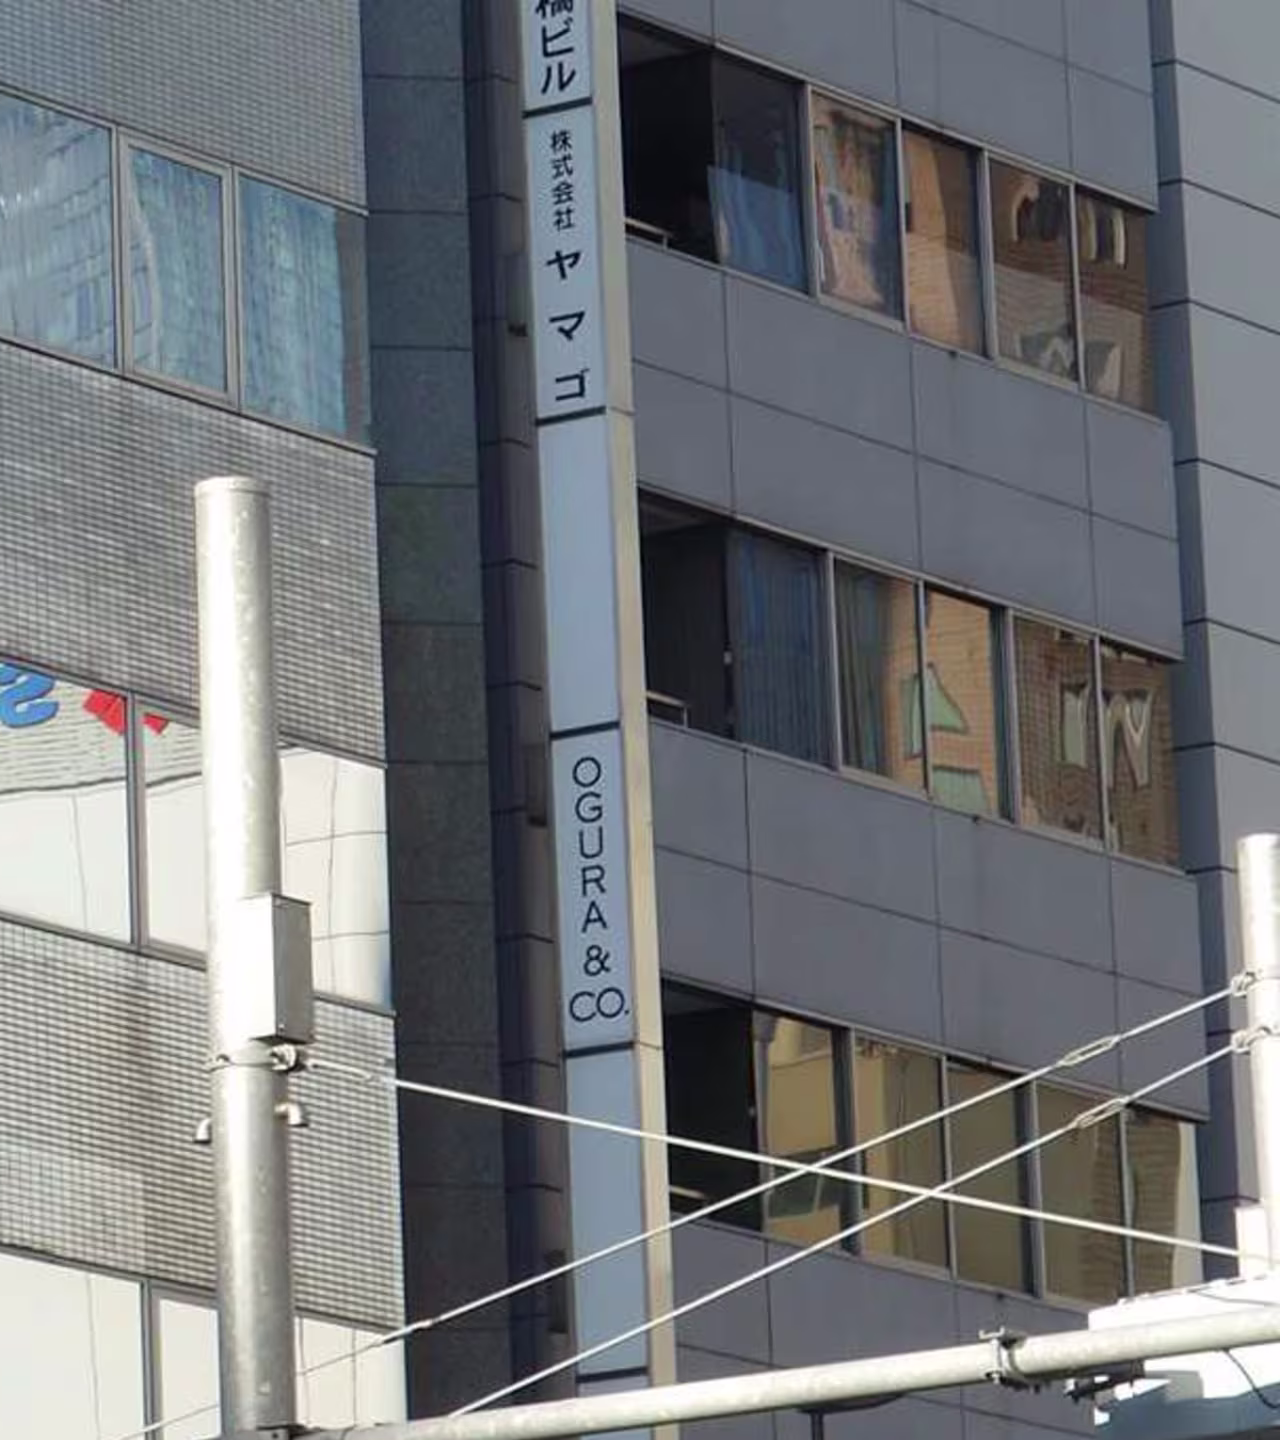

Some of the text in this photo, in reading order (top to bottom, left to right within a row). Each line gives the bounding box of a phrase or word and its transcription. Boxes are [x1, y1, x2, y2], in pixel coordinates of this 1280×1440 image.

[547, 129, 590, 403] 株式会社ヤマゴ
[569, 756, 630, 1023] OGURA & CO.
